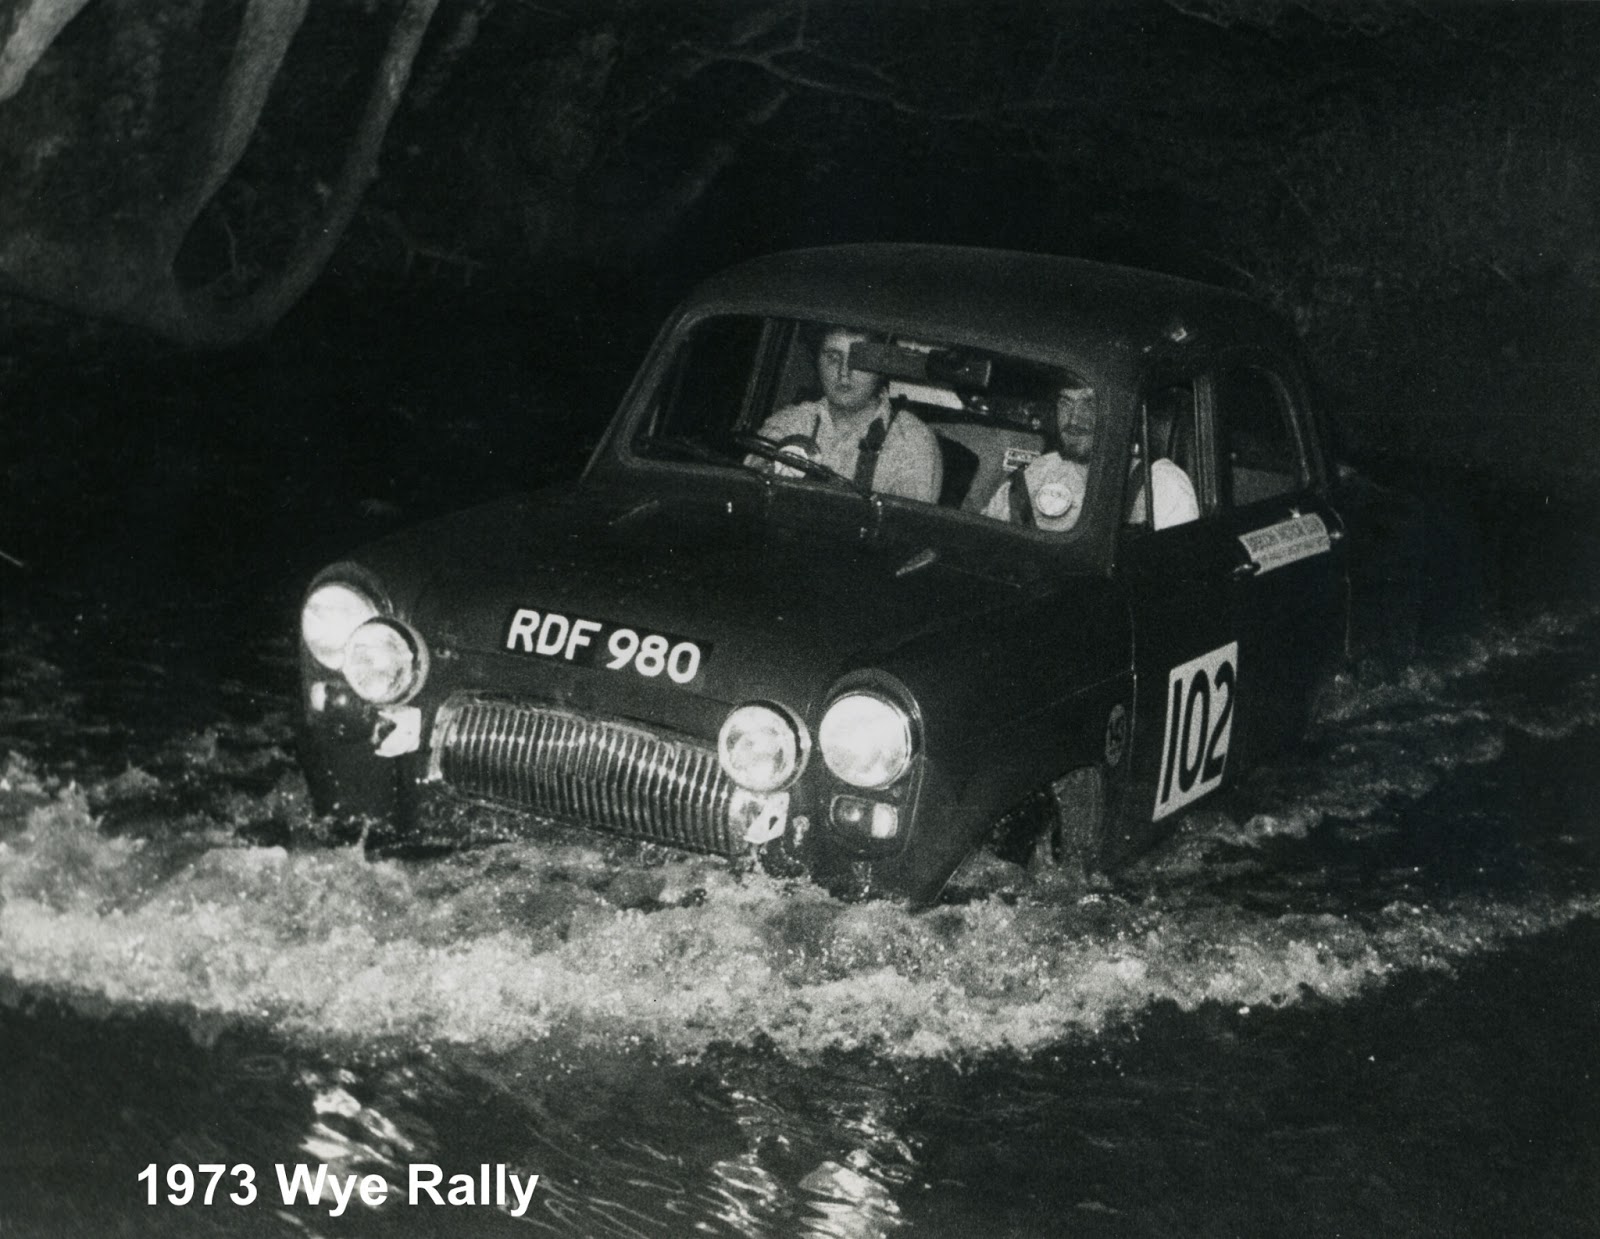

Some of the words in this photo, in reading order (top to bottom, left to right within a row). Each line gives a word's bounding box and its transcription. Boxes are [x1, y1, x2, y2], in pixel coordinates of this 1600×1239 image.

[507, 608, 603, 660] RDF
[606, 628, 701, 684] 980
[1160, 660, 1236, 804] 102
